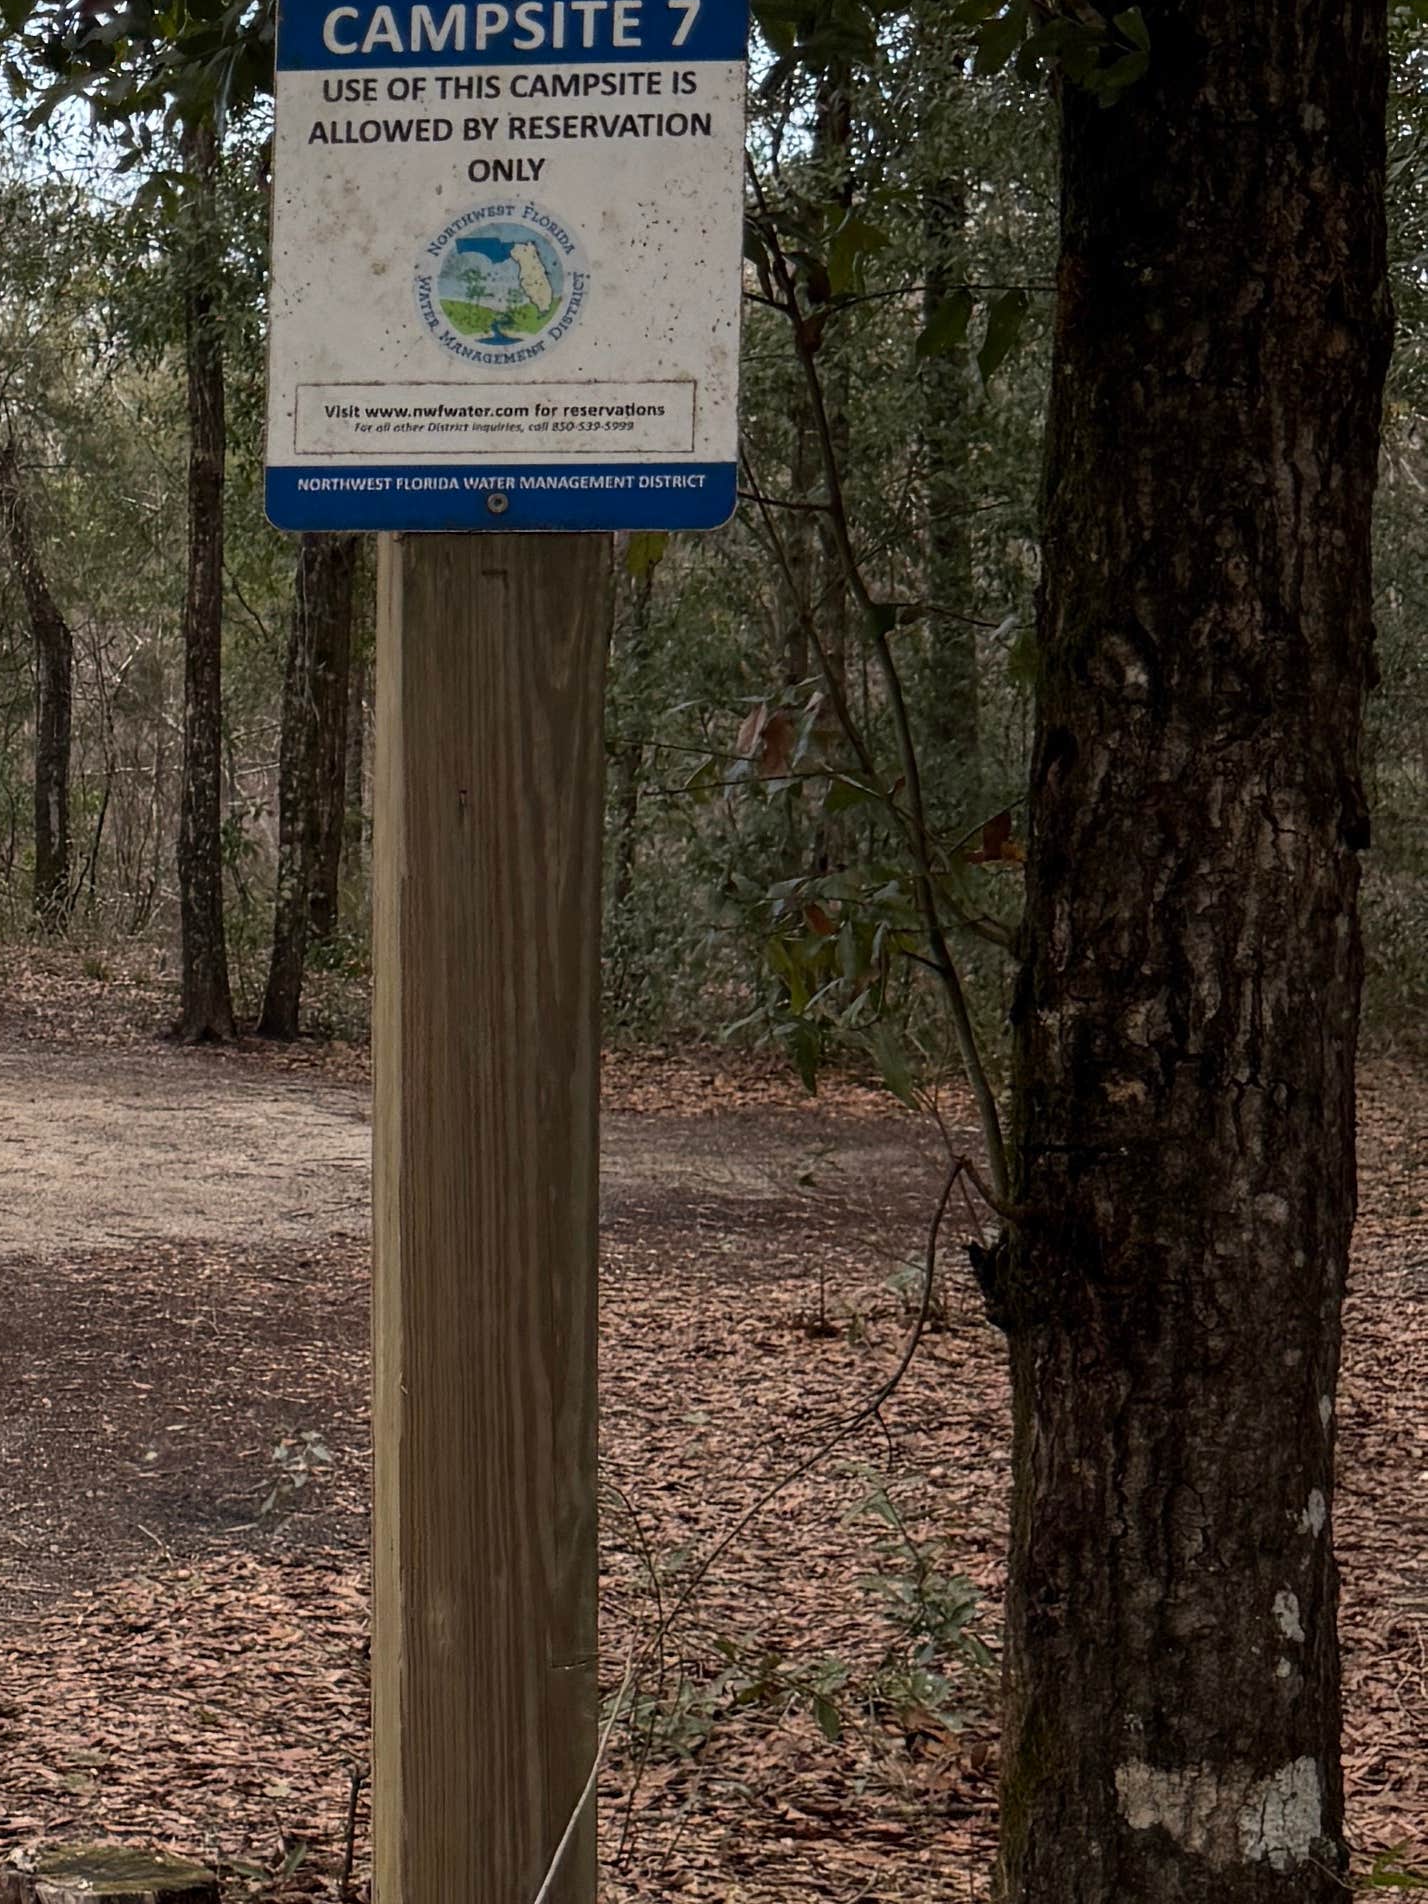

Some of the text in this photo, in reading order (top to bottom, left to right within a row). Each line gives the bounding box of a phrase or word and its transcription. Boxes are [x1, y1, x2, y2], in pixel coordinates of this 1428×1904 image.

[321, 0, 643, 55] CAMPSITE
[322, 71, 697, 102] USE OF THIS CAMPSITE IS
[307, 113, 712, 145] ALLOWED BY RESERVATION
[467, 158, 545, 183] ONLY
[426, 204, 576, 257] NORTHWEST FLORIDA
[417, 271, 585, 365] WATER MANAGEMENT DISTRICT
[324, 402, 666, 418] Visit www.nwfwater.com for reservations
[354, 421, 635, 434] For all other District inquiries, call 850-539-5999
[297, 474, 706, 491] NORTHWEST FLORIDA WATER MANAGEMENT DISTRICT
